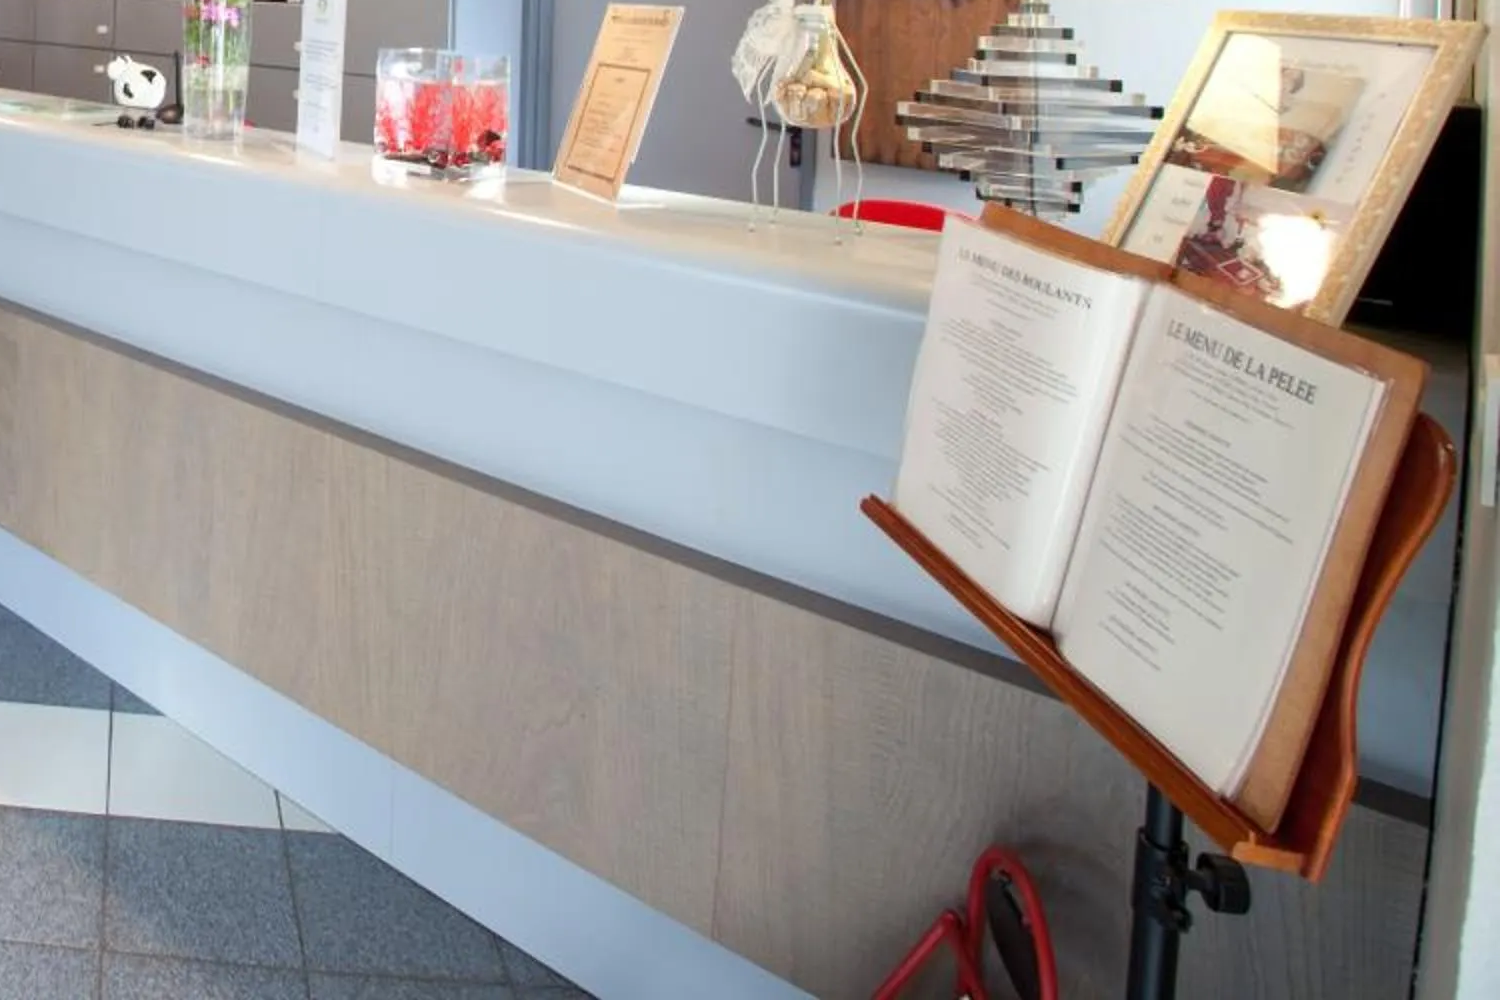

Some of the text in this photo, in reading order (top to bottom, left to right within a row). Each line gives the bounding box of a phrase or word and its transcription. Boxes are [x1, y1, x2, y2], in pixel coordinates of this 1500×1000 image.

[1166, 319, 1184, 340] LE
[1186, 327, 1224, 359] MENU
[1222, 345, 1245, 370] DE
[1245, 356, 1265, 381] LA
